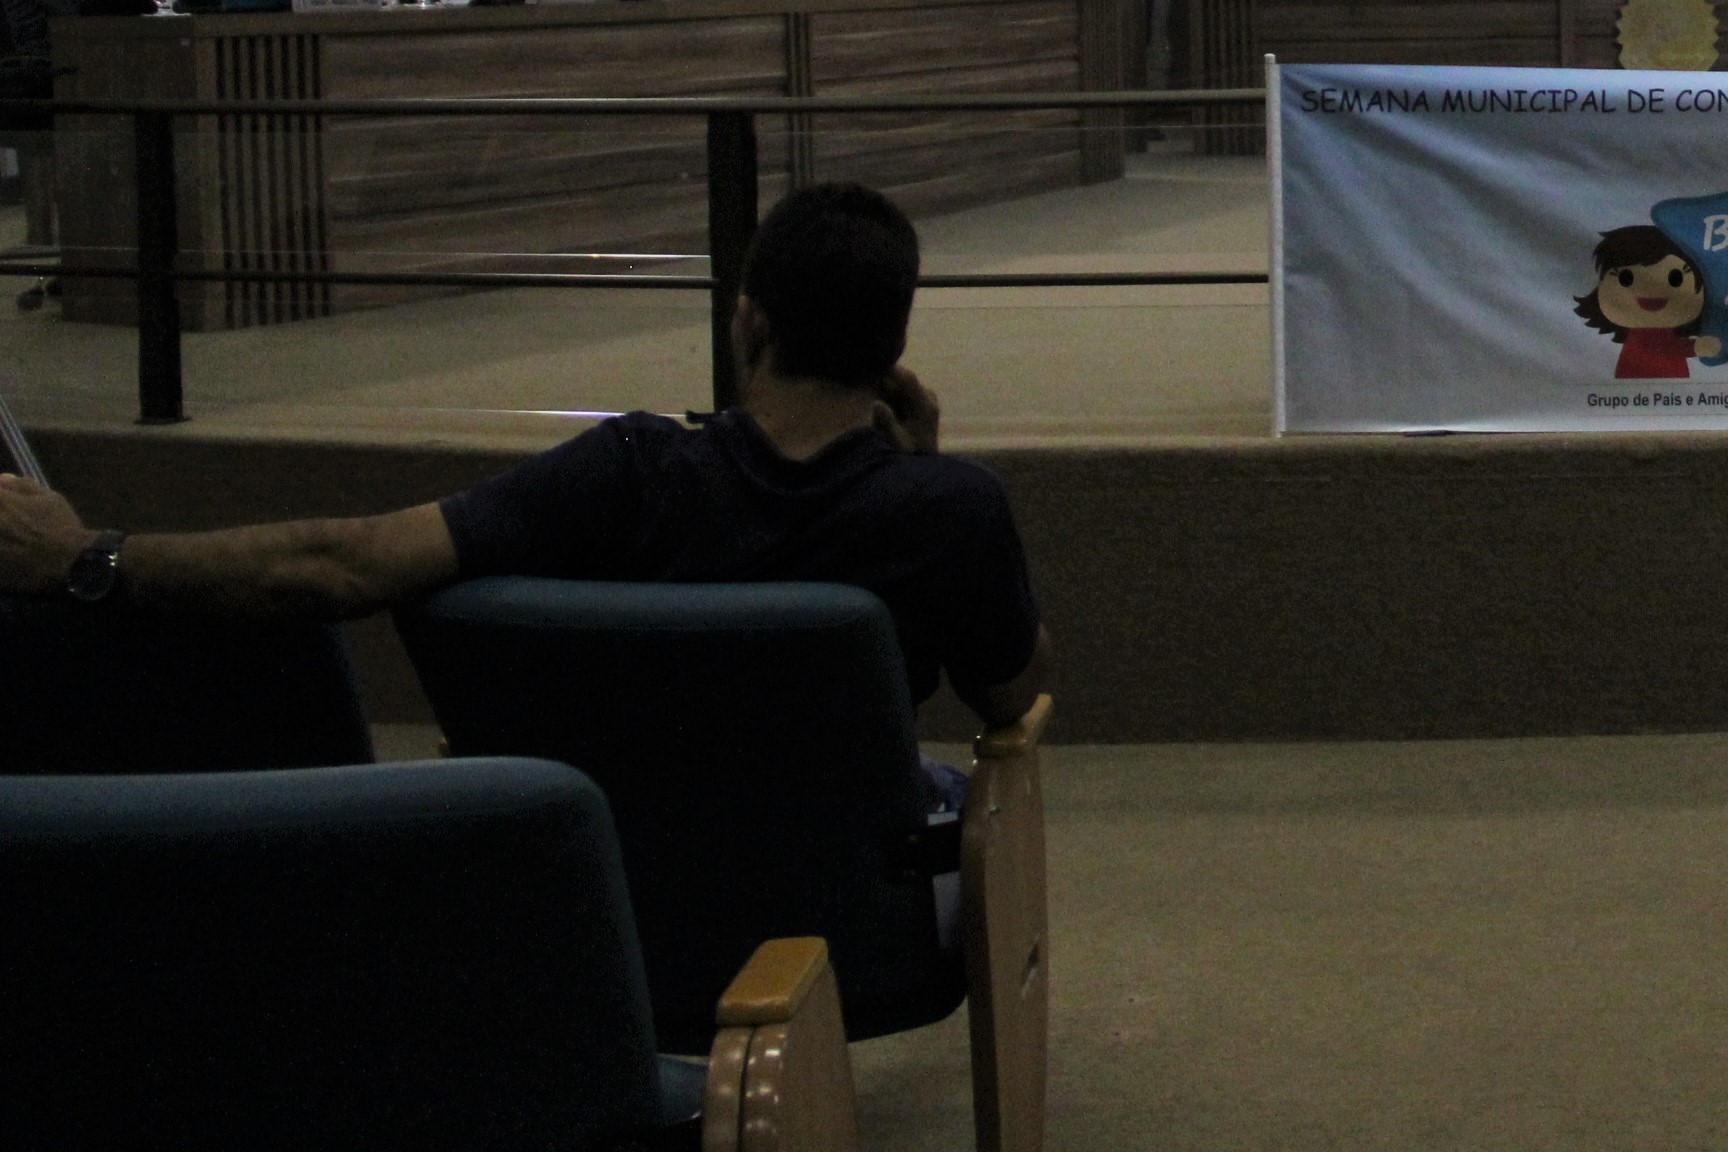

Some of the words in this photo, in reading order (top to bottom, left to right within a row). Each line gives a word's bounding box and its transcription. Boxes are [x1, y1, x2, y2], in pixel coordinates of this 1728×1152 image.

[1301, 88, 1430, 113] SEMANA
[1441, 88, 1616, 113] MUNICIPAL
[1628, 89, 1665, 113] DE
[1586, 393, 1629, 410] Grupo
[1633, 393, 1650, 406] de
[1654, 392, 1682, 406] Pais
[1686, 396, 1694, 406] e
